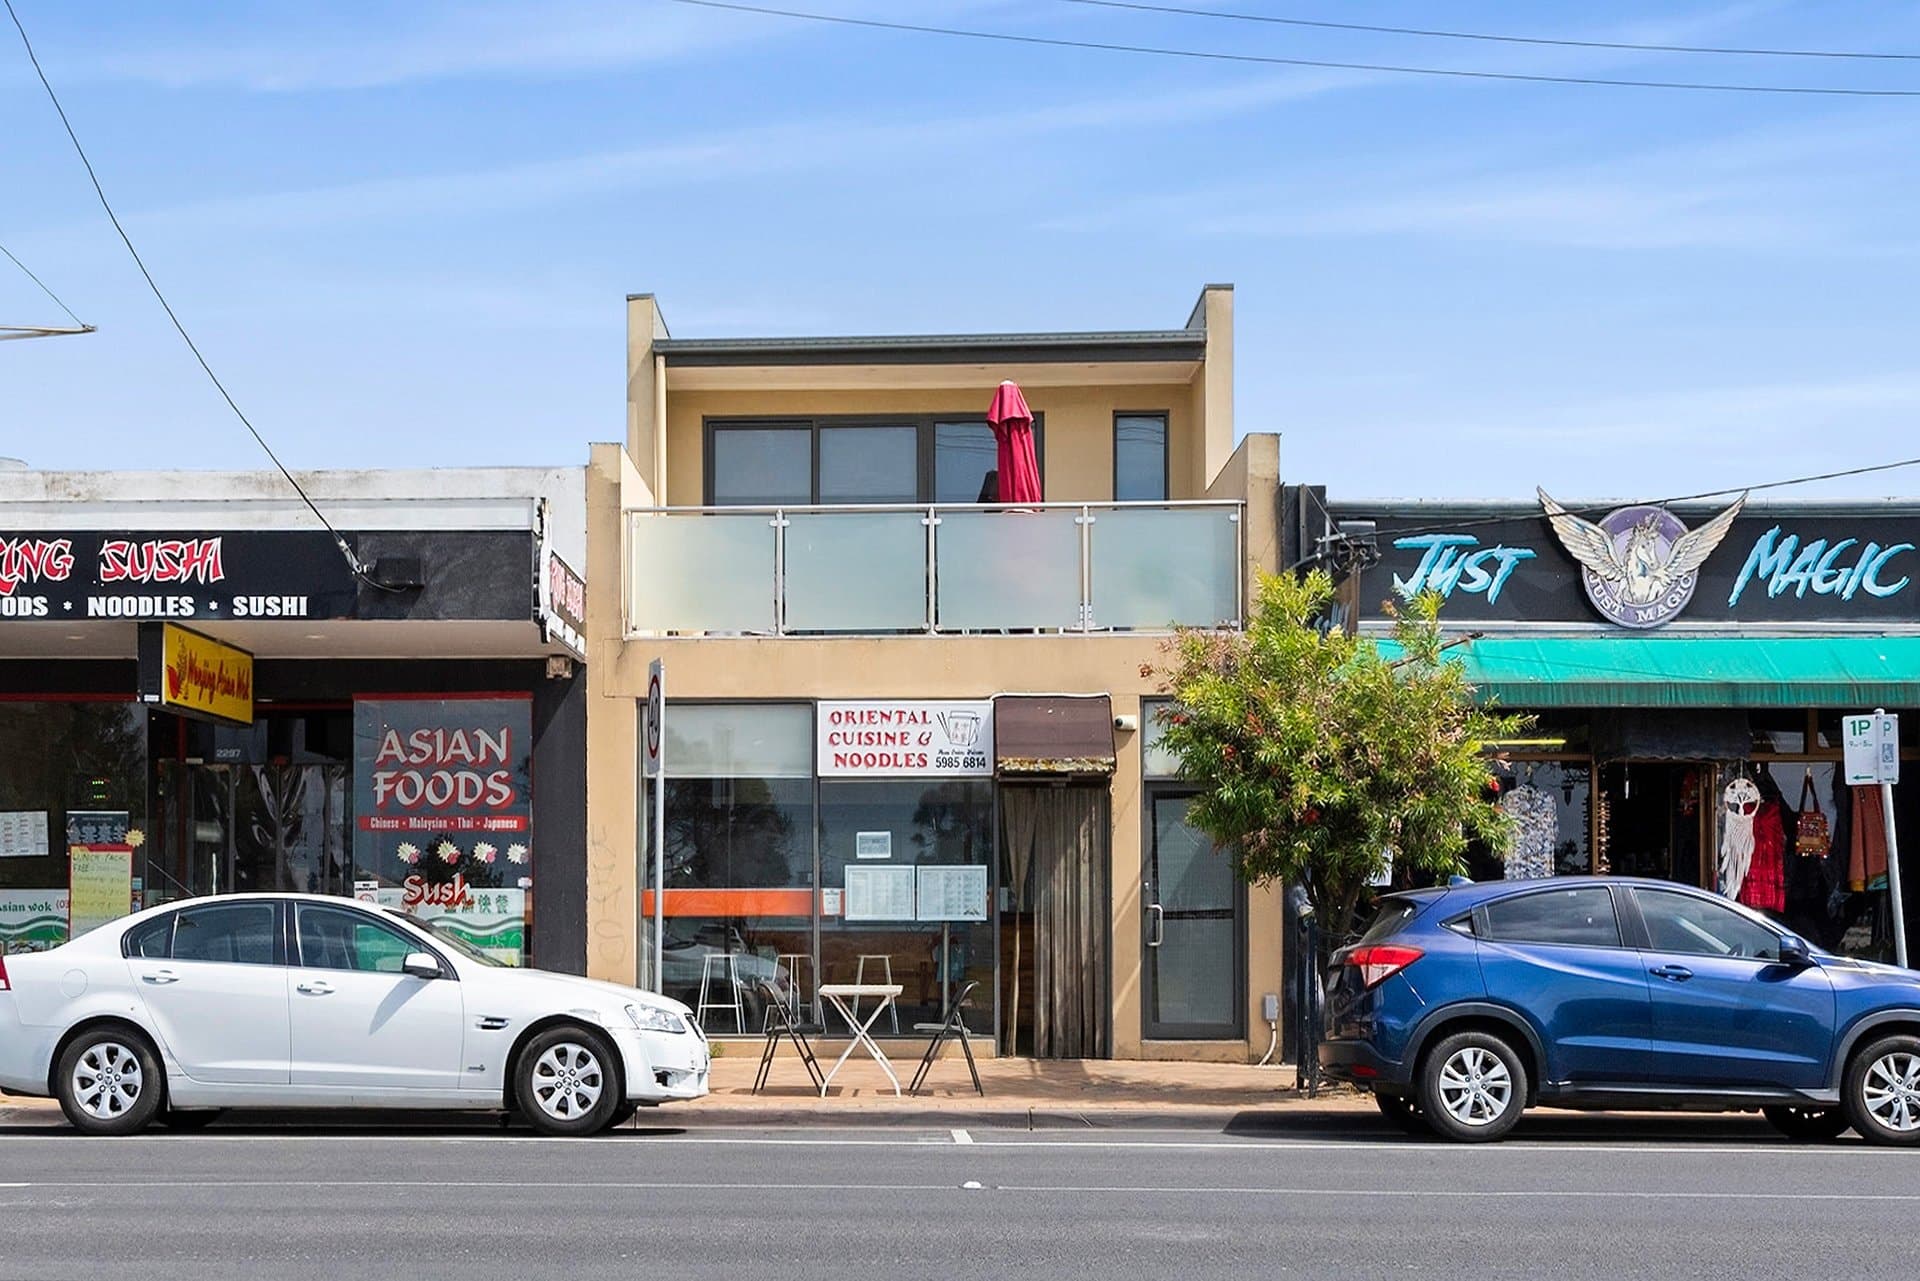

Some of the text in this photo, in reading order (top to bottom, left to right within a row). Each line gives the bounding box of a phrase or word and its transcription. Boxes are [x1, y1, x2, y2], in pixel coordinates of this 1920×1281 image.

[0, 536, 225, 597] ING SUSHI
[1392, 524, 1917, 608] JUST MAGIC
[0, 596, 308, 617] ODS NOODLES SUSHI
[1588, 574, 1693, 623] JUST MAGIC
[829, 710, 932, 725] ORIENTAL
[1850, 719, 1871, 737] 1P
[375, 727, 512, 767] ASIAN
[828, 731, 932, 746] CUISINE &
[834, 752, 928, 769] NOODLES
[935, 756, 986, 769] 5985 6814
[372, 770, 516, 810] FOODS
[370, 816, 518, 831] Chinese Malaysian Thai Japanese
[403, 873, 474, 906] Sush
[0, 901, 26, 912] sian
[28, 901, 52, 912] wok
